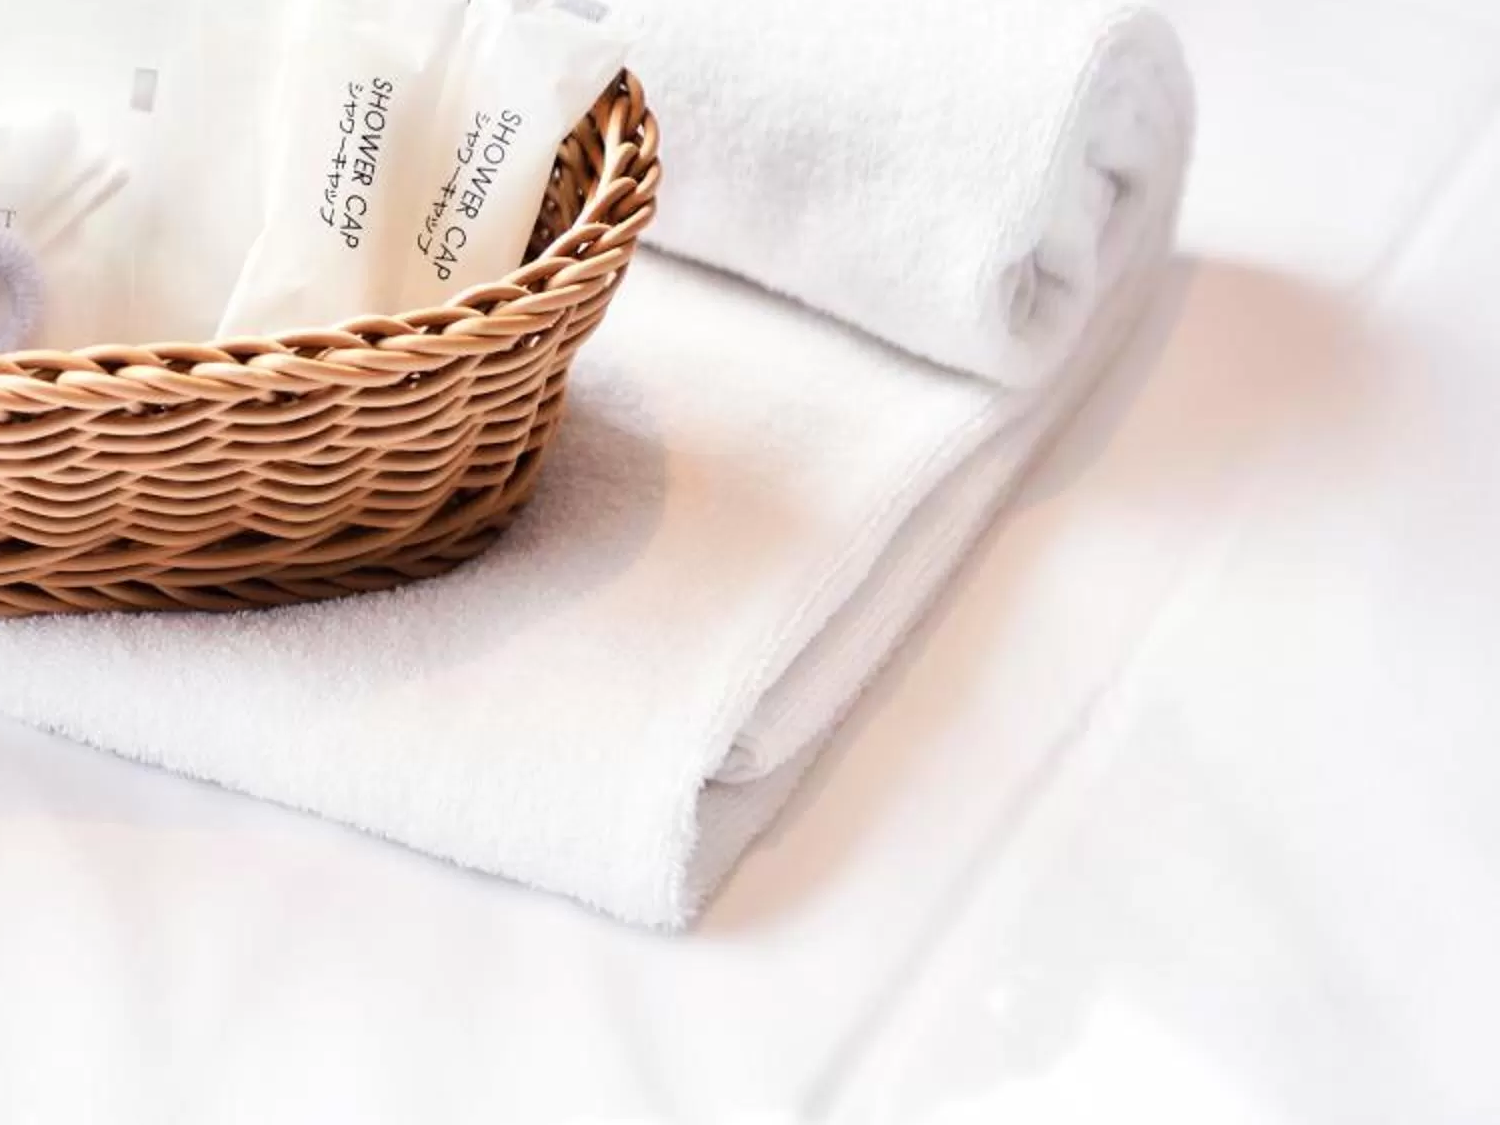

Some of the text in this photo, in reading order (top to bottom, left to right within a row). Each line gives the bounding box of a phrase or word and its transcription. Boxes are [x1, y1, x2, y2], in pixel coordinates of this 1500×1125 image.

[339, 77, 394, 249] SHOWER CAP
[433, 109, 523, 281] SHOWER CAP
